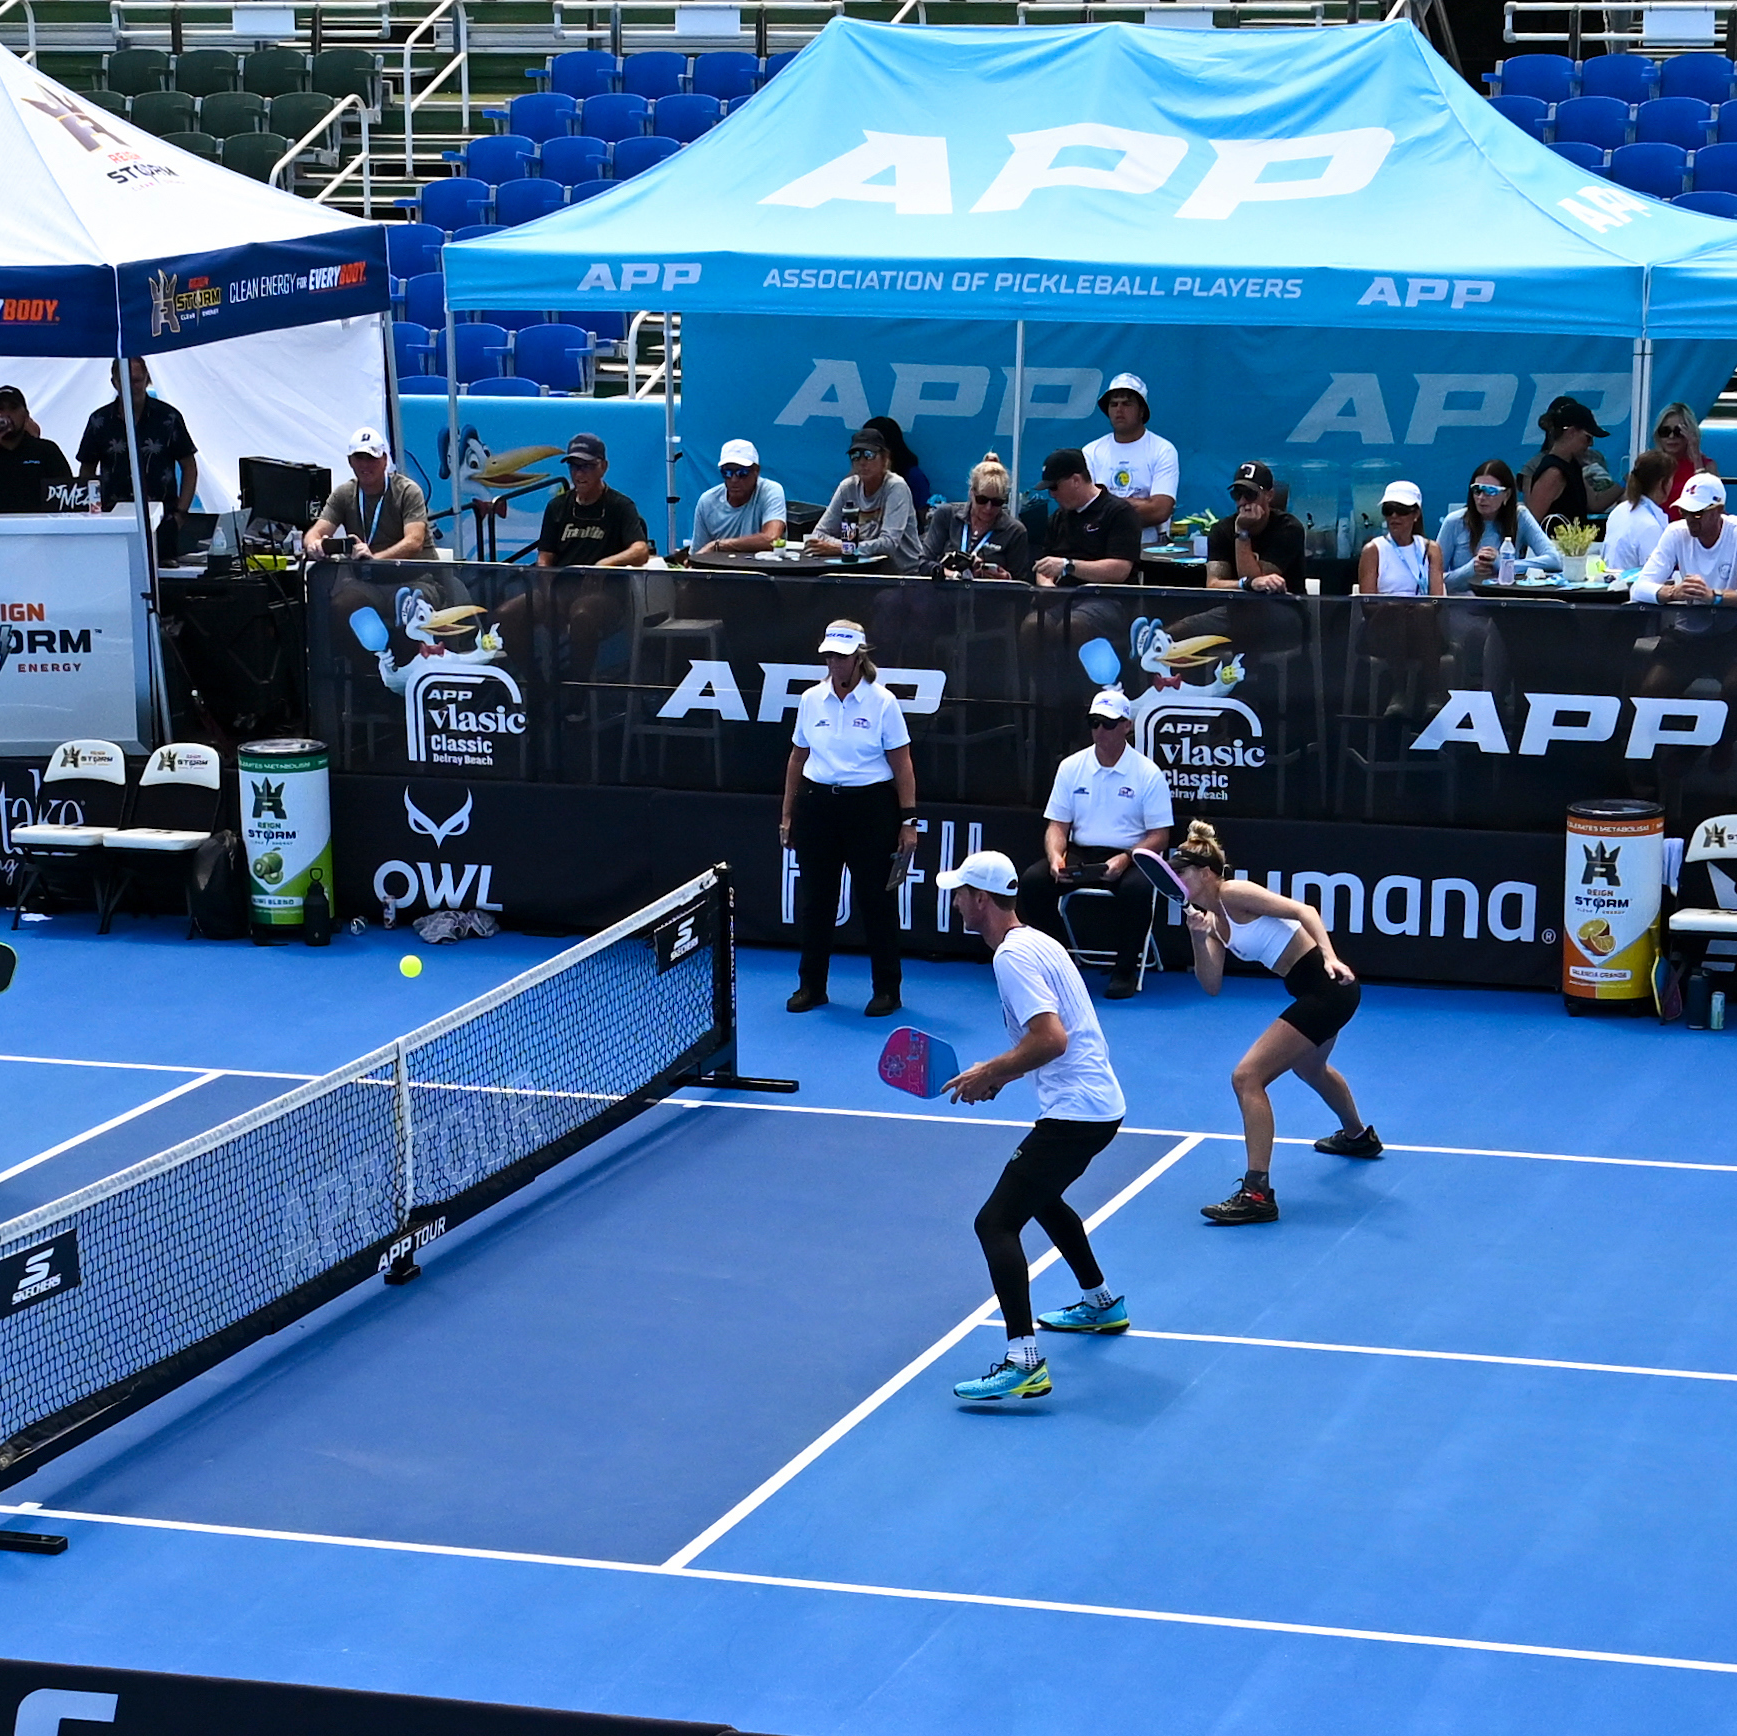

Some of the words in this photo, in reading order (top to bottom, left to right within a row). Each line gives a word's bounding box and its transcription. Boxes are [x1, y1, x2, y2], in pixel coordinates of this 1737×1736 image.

[758, 121, 1397, 222] APP
[229, 277, 259, 304] CLEAN
[261, 272, 297, 299] ENERGY
[577, 262, 703, 294] APP
[763, 266, 946, 294] ASSOCIATION
[951, 269, 990, 294] OF
[995, 270, 1167, 298] PICKLEBALL
[1173, 274, 1304, 300] PLAYERS
[1358, 275, 1496, 310] APP
[773, 358, 1104, 437] APP
[18, 662, 82, 673] ENERGY
[427, 689, 473, 702] APP
[429, 703, 526, 736] vlasic
[1160, 722, 1209, 734] APP
[1409, 690, 1728, 760] APP
[431, 734, 493, 755] Classic
[433, 753, 462, 767] Delray
[464, 754, 494, 767] Beach
[1159, 737, 1266, 769] vlasic
[1170, 788, 1197, 802] elray
[248, 829, 297, 840] STORM
[374, 860, 503, 912] OWL
[1587, 888, 1614, 897] REIGN
[1574, 896, 1630, 909] STORM
[377, 1236, 412, 1272] APP
[414, 1216, 447, 1250] TOUR
[11, 1272, 63, 1306] SKECHERS
